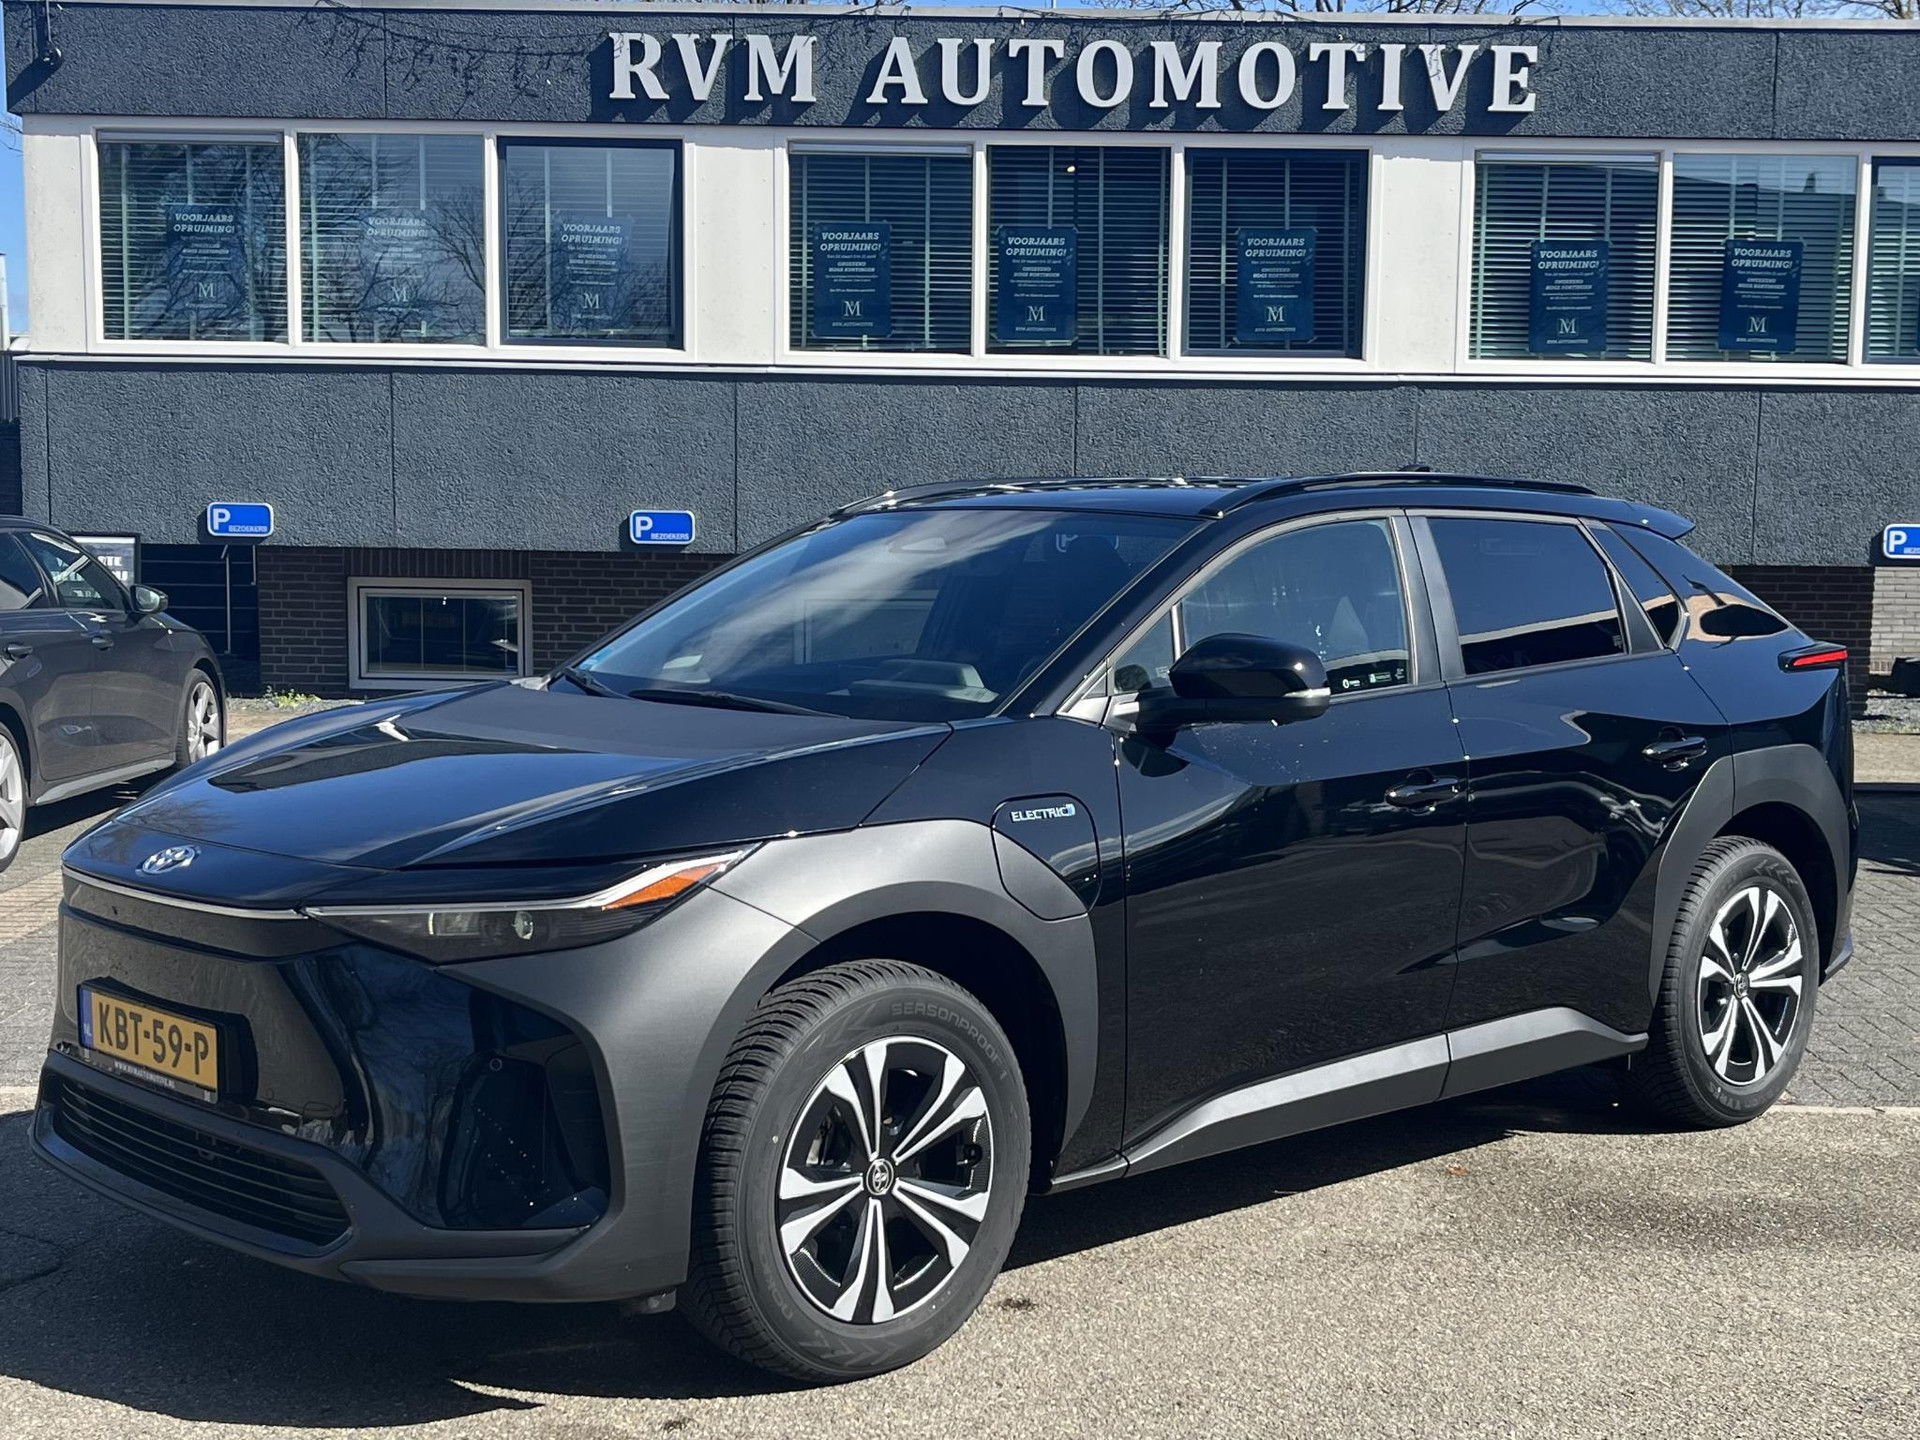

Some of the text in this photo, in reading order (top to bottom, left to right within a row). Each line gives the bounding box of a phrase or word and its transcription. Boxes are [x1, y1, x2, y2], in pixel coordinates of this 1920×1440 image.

[608, 32, 1538, 113] RVM AUTOMOTIVE
[175, 213, 234, 222] VOORJAARS
[173, 224, 235, 233] OPRUIMING!
[563, 224, 621, 234] VOORJAARS
[561, 234, 623, 244] OPRUIMING!
[821, 232, 880, 241] VOORJAARS
[1007, 237, 1066, 246] VOORJAARS
[820, 243, 881, 251] OPRUIMING!
[1247, 238, 1305, 247] VOORJAARS
[1005, 247, 1067, 257] OPRUIMING!
[1245, 248, 1307, 257] OPRUIMING!
[1540, 249, 1598, 259] VOORJAARS
[1734, 248, 1792, 258] VOORJAARS
[1537, 261, 1600, 269] OPRUIMING!
[1731, 258, 1793, 268] OPRUIMING!
[212, 508, 231, 531] P
[635, 516, 653, 538] P
[1889, 530, 1907, 553] P
[1010, 806, 1068, 822] ELECTRIC
[98, 1002, 209, 1075] KBT-59-P
